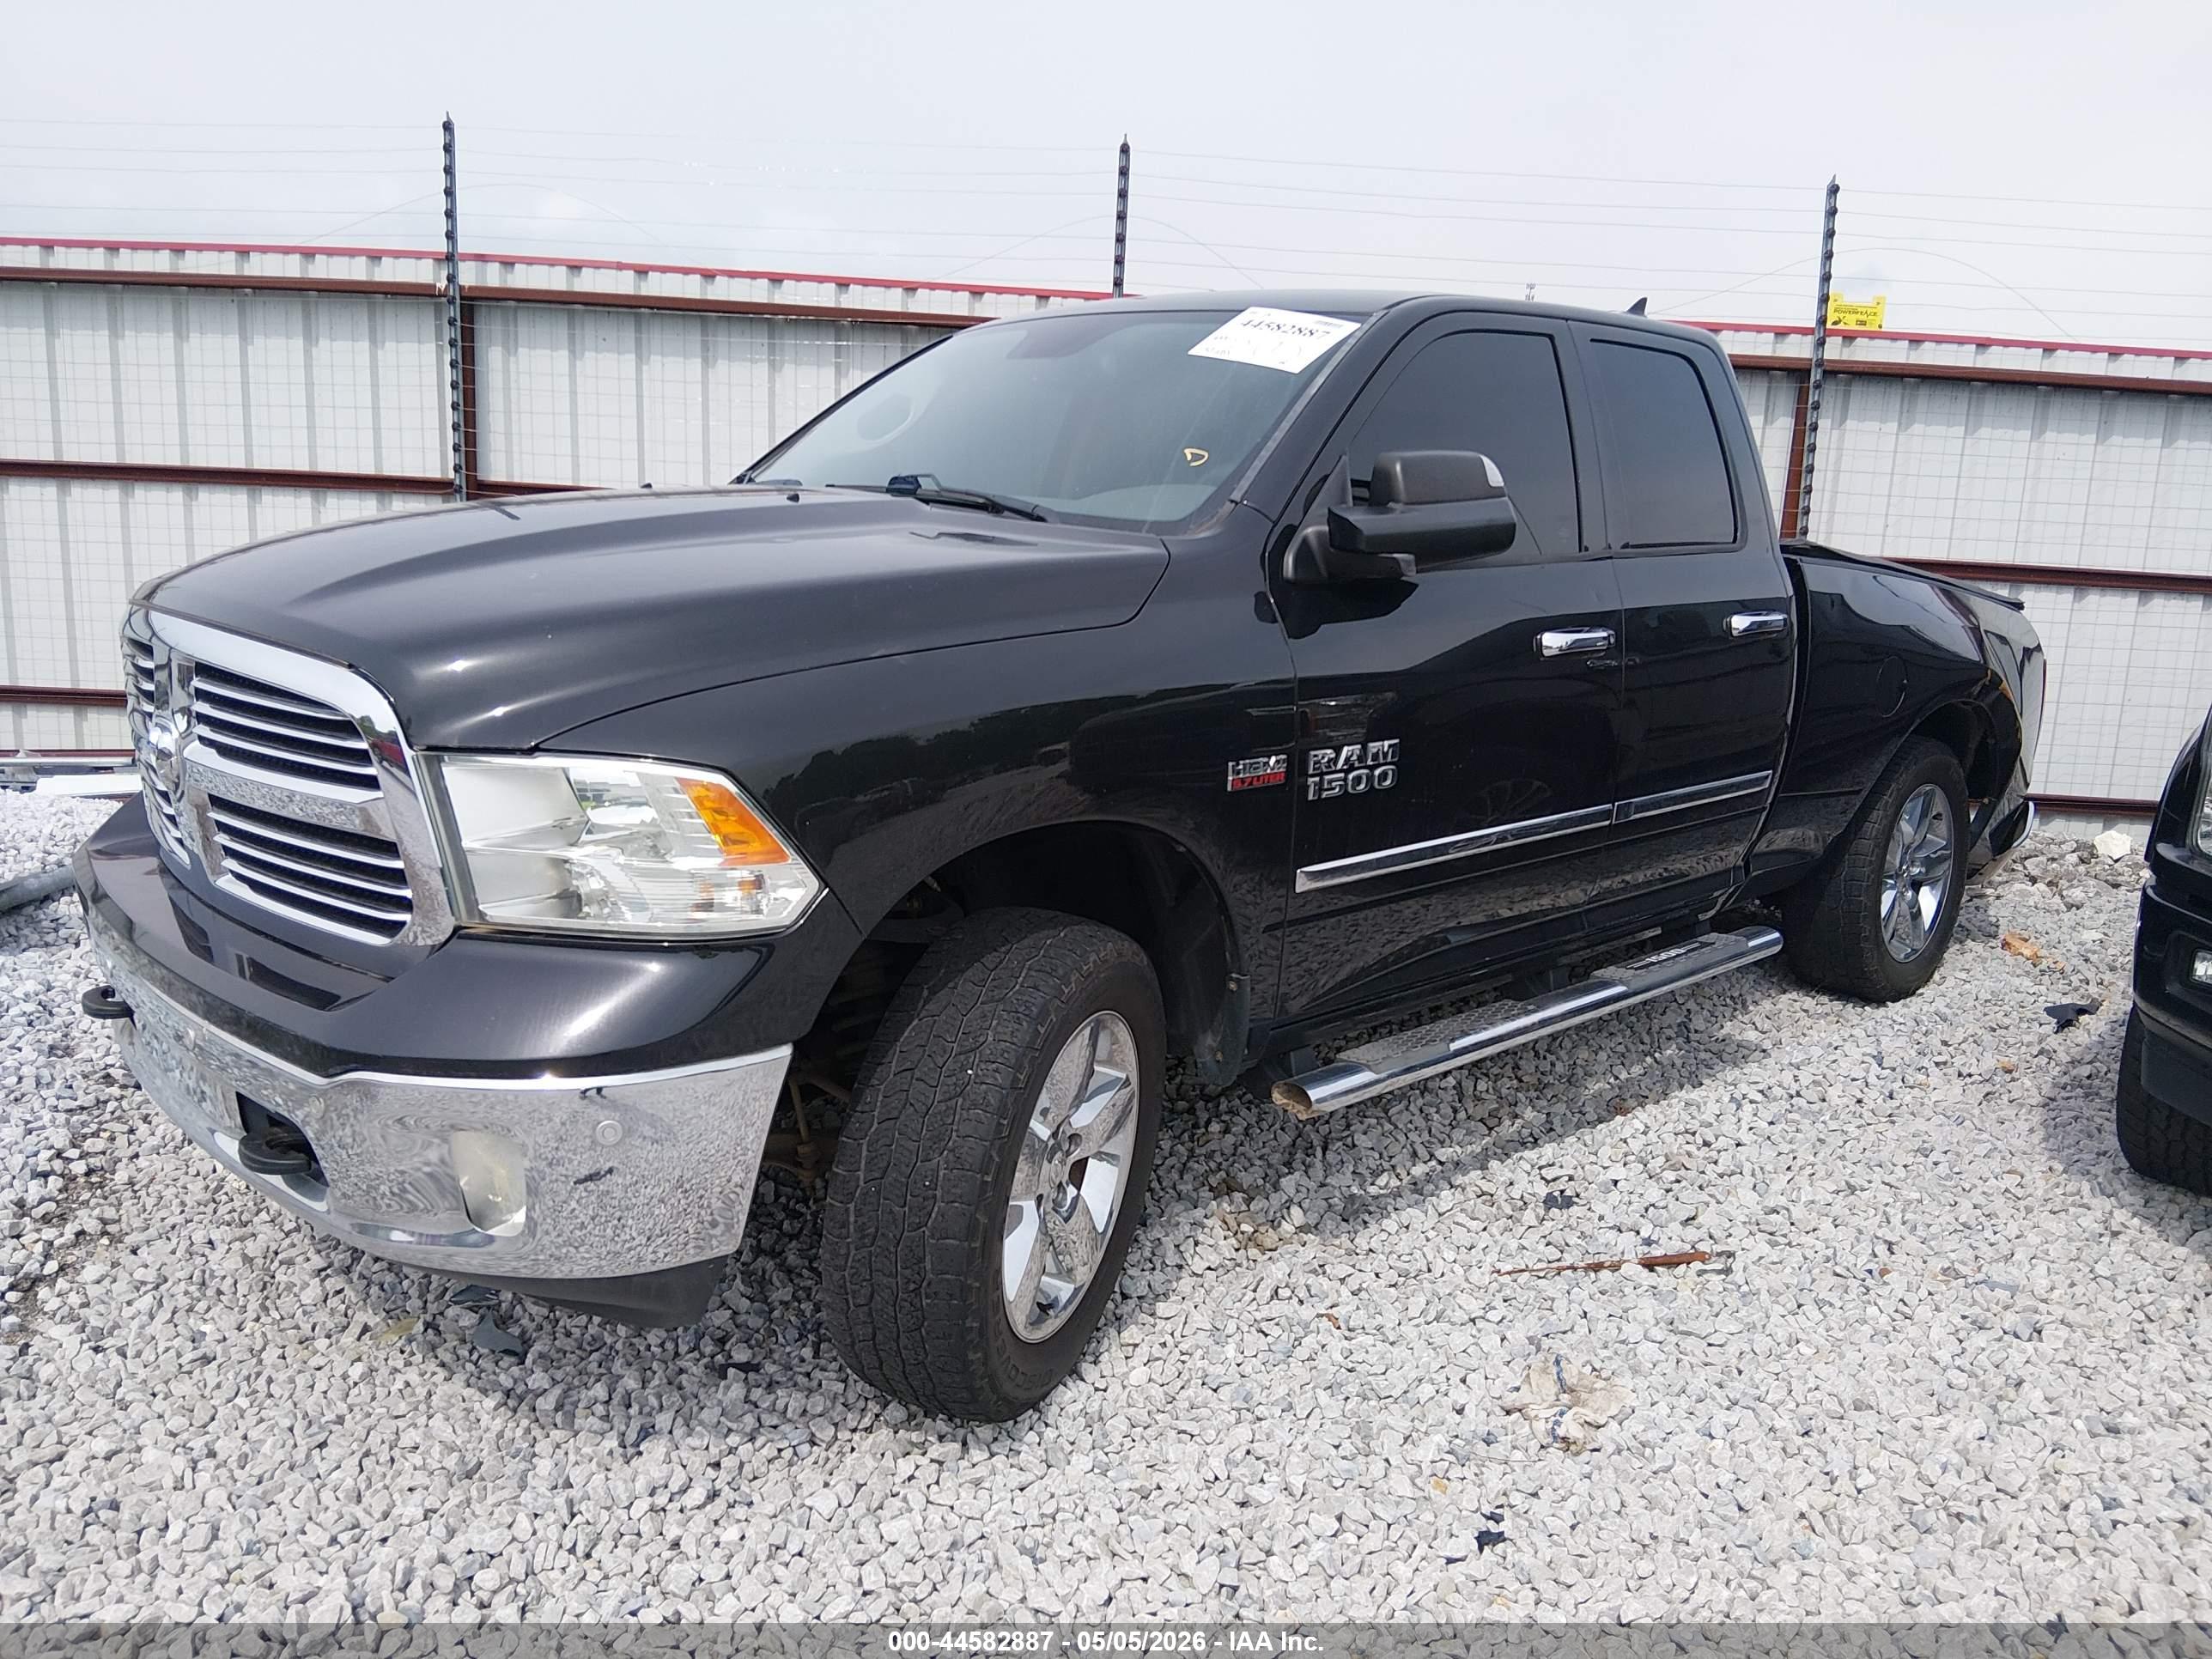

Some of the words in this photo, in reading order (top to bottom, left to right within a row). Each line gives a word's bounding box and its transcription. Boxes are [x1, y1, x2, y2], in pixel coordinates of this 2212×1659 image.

[1308, 738, 1401, 775] RAM
[1307, 765, 1398, 800] 1500
[1644, 948, 1687, 963] 1500
